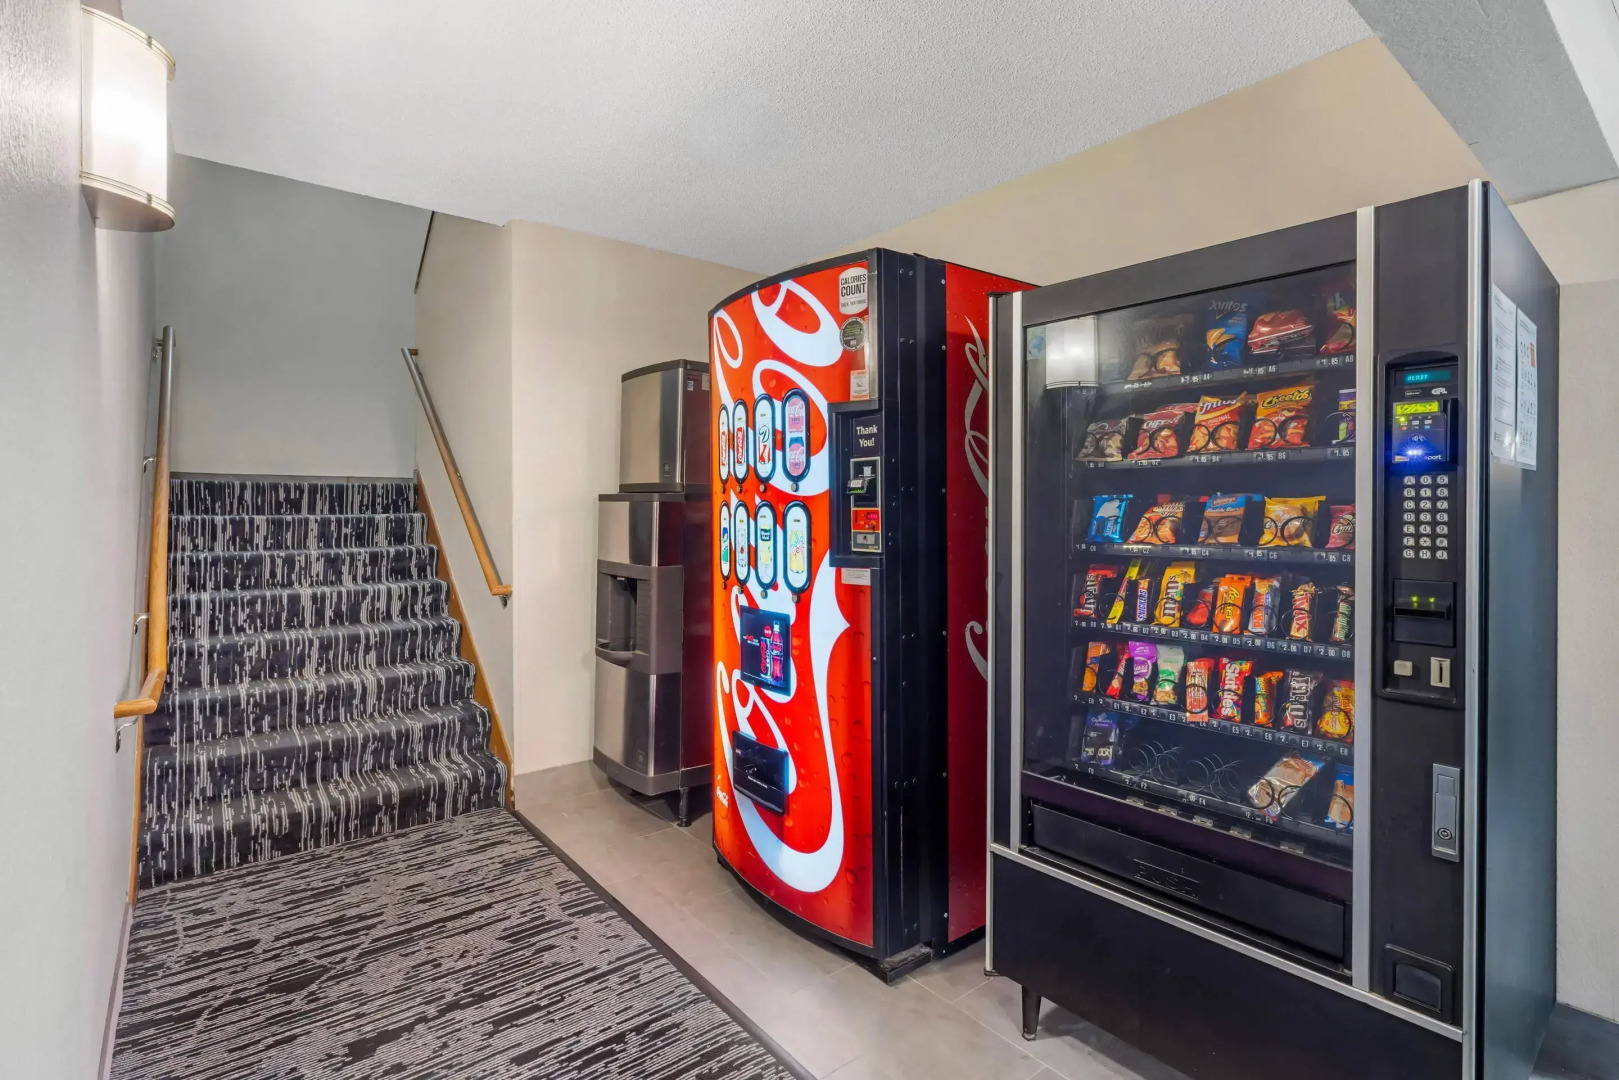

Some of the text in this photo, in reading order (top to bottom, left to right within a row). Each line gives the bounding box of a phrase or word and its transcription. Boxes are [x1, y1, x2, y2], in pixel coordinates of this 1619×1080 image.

[841, 274, 866, 285] CALORIES
[841, 283, 866, 297] COUNT
[1261, 388, 1312, 409] Cheetos
[856, 425, 878, 436] Thank
[859, 438, 875, 448] You!
[1342, 554, 1350, 562] C8
[1342, 650, 1351, 658] D8
[1221, 663, 1239, 716] Skittles
[1340, 748, 1348, 756] E8
